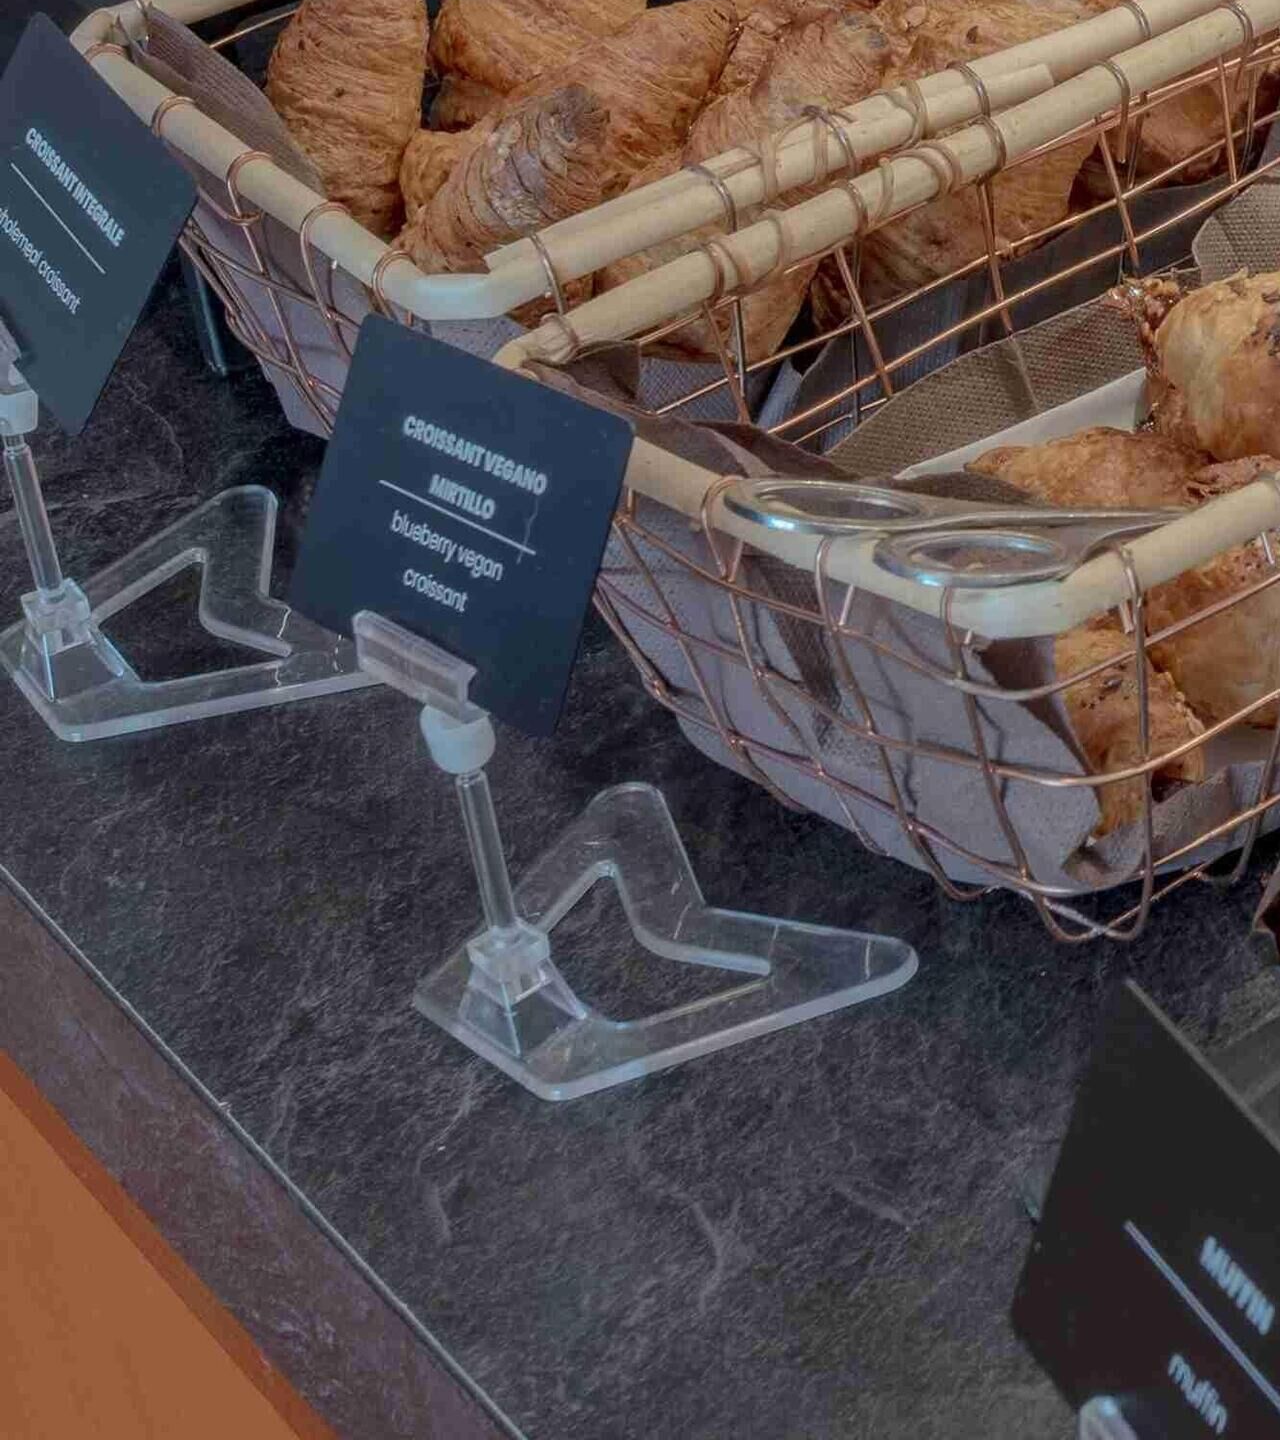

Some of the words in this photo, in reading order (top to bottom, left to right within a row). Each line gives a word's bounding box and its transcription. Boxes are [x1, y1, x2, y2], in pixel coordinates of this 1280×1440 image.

[25, 127, 79, 197] CROISSANT
[72, 182, 126, 247] INTEGRALE
[0, 208, 41, 264] holemeal
[38, 259, 81, 314] croissant
[403, 416, 487, 466] CROISSANT
[484, 450, 547, 495] VEGANO
[428, 474, 496, 520] MIRTILLO
[390, 510, 457, 564] blueberry
[458, 544, 503, 581] vegan
[403, 569, 468, 612] croissant
